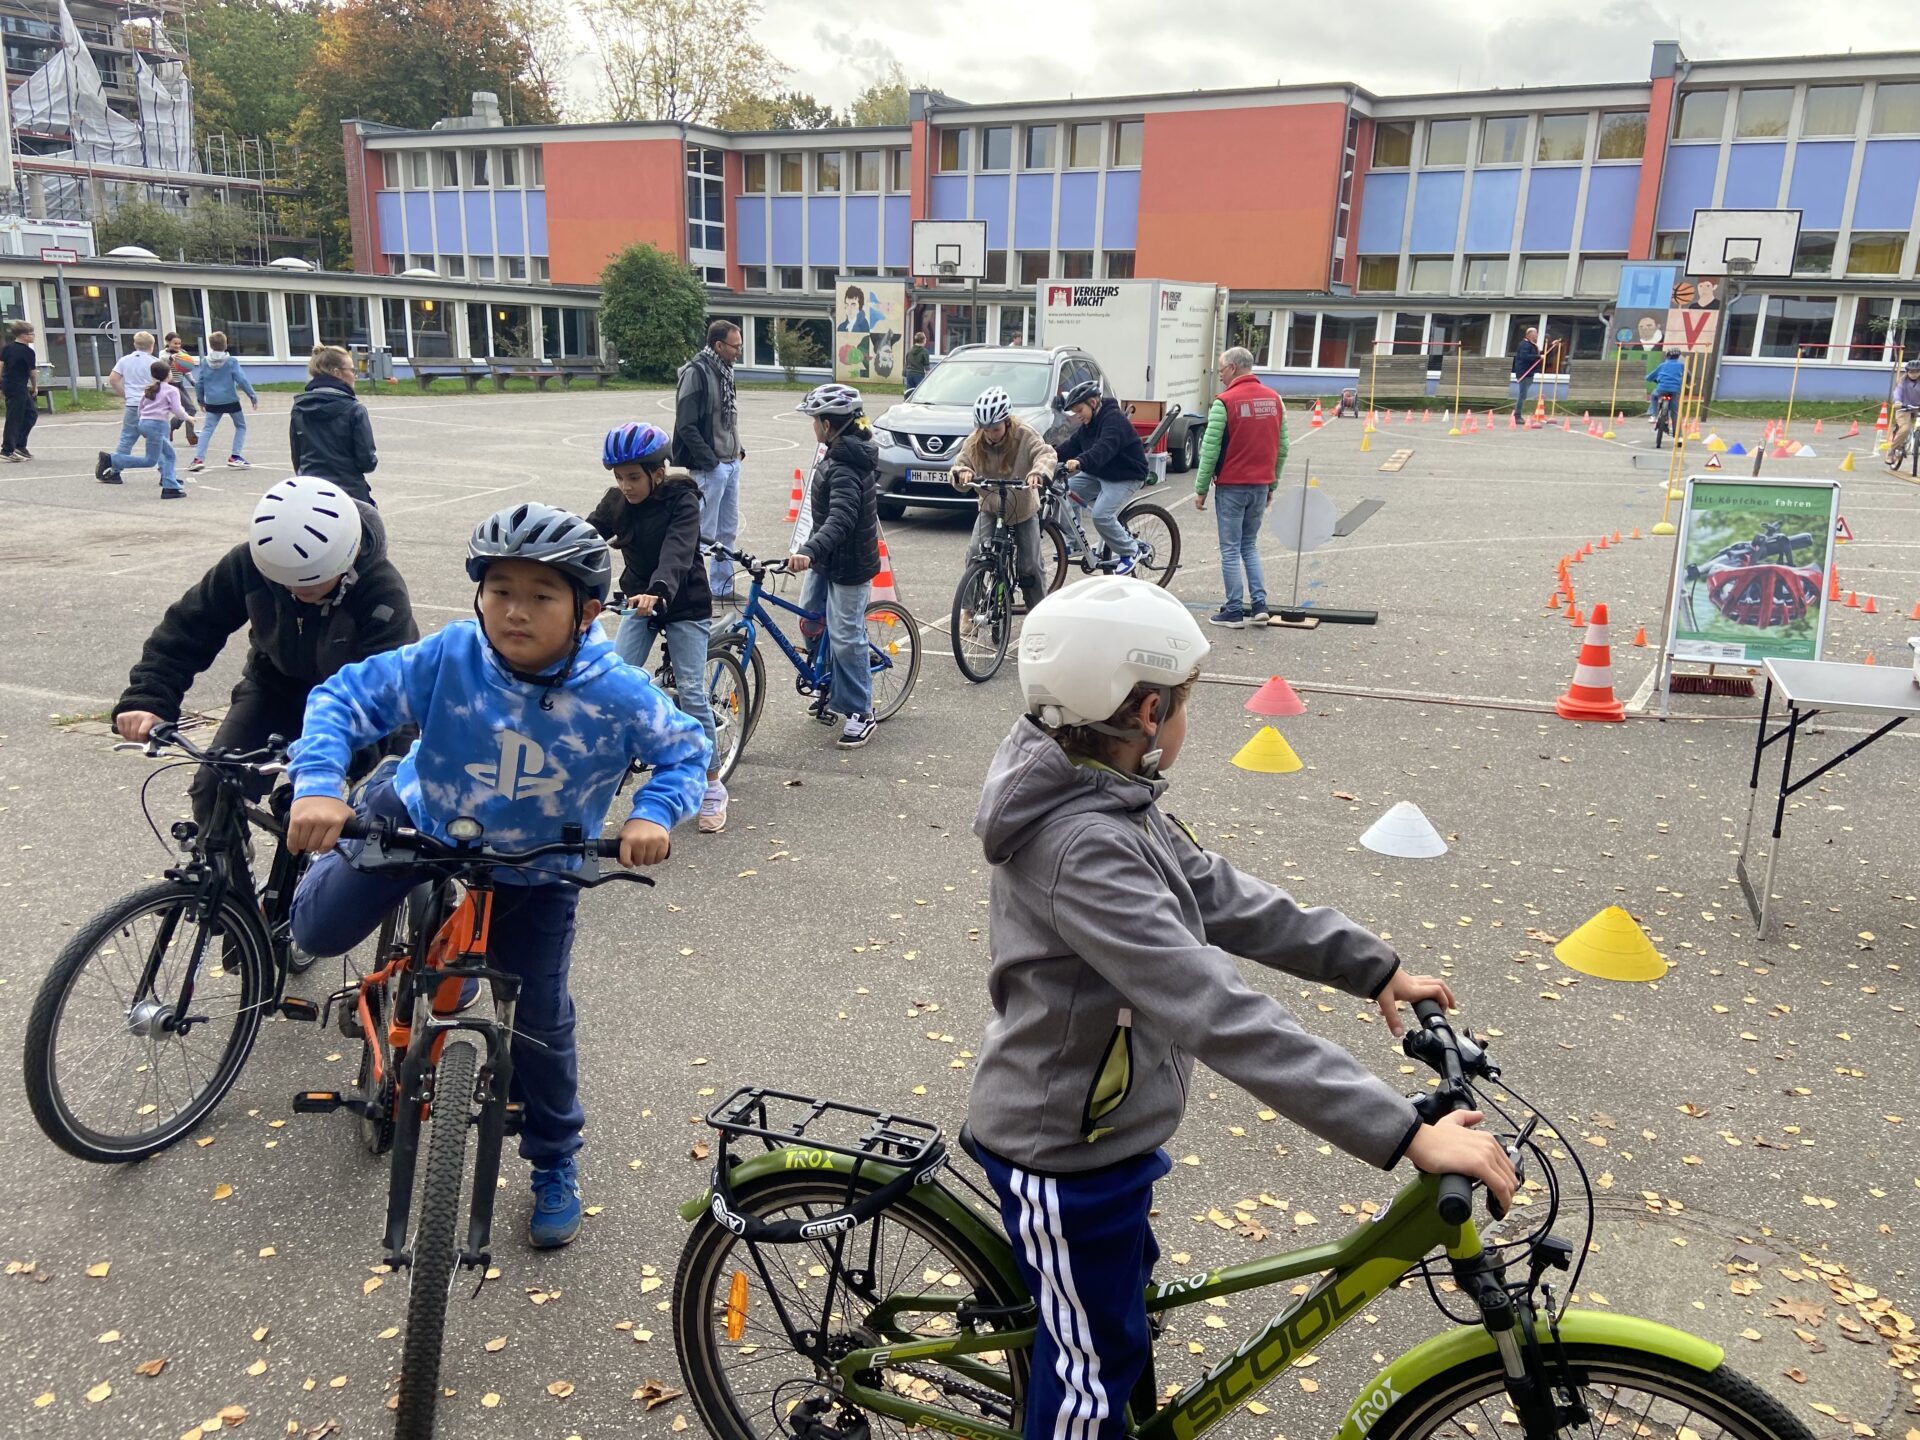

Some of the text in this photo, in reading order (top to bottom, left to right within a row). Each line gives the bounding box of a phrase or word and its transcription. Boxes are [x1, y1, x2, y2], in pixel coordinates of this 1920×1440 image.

[1074, 286, 1119, 297] VERKEHRS
[1629, 269, 1660, 306] H
[1073, 296, 1105, 307] WACHT
[1682, 311, 1711, 351] V
[911, 472, 922, 480] HH
[1775, 498, 1812, 508] fahren
[1135, 652, 1174, 670] ABUS
[785, 1150, 834, 1169] TROX
[806, 1217, 850, 1239] ABUS
[1156, 1266, 1223, 1299] TROX
[1186, 1284, 1367, 1434] SCOOL
[1351, 1375, 1402, 1434] TROX
